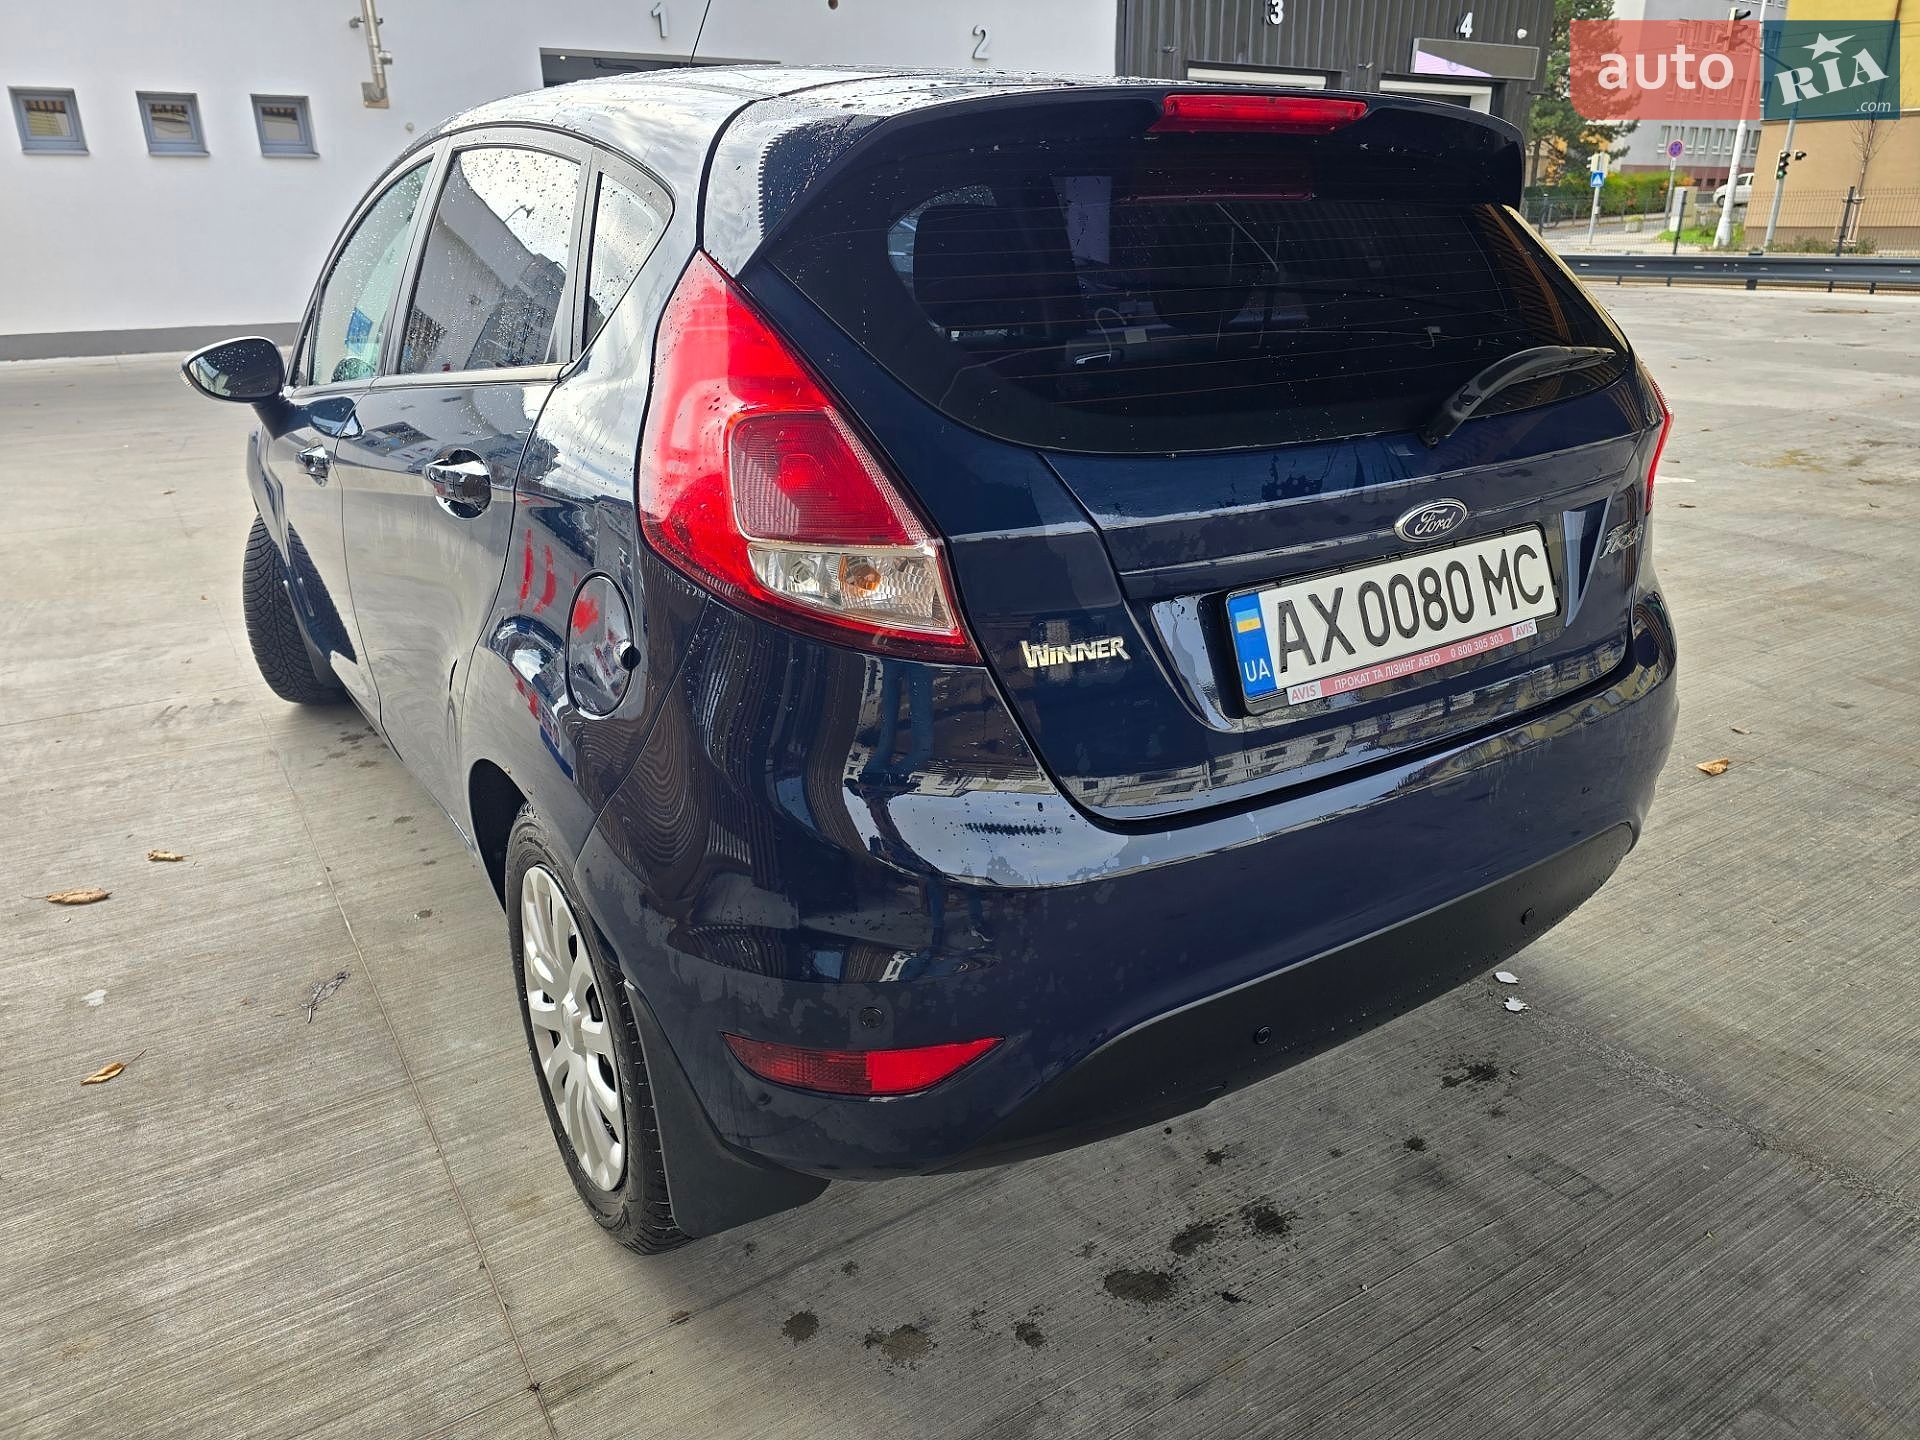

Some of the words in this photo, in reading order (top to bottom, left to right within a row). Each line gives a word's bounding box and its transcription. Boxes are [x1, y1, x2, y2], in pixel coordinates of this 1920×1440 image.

[650, 3, 670, 38] 1
[1268, 0, 1284, 25] 3
[1458, 12, 1473, 38] 4
[971, 24, 991, 60] 2
[1414, 507, 1456, 536] Ford
[1277, 587, 1356, 674] AX
[1358, 560, 1475, 647] 0080
[1478, 544, 1545, 617] MC
[1515, 621, 1534, 638] AVIS
[1020, 635, 1131, 669] WINNER
[1334, 672, 1370, 690] ПРОКАТ
[1373, 669, 1384, 680] ТА
[1384, 659, 1416, 677] ЛІЗИНГ
[1418, 652, 1441, 668] АВТО
[1450, 648, 1456, 658] 0
[1458, 642, 1473, 656] 800
[1475, 637, 1488, 650] 305
[1490, 633, 1504, 647] 303
[1244, 659, 1271, 682] UA
[1291, 684, 1316, 701] AVIS
